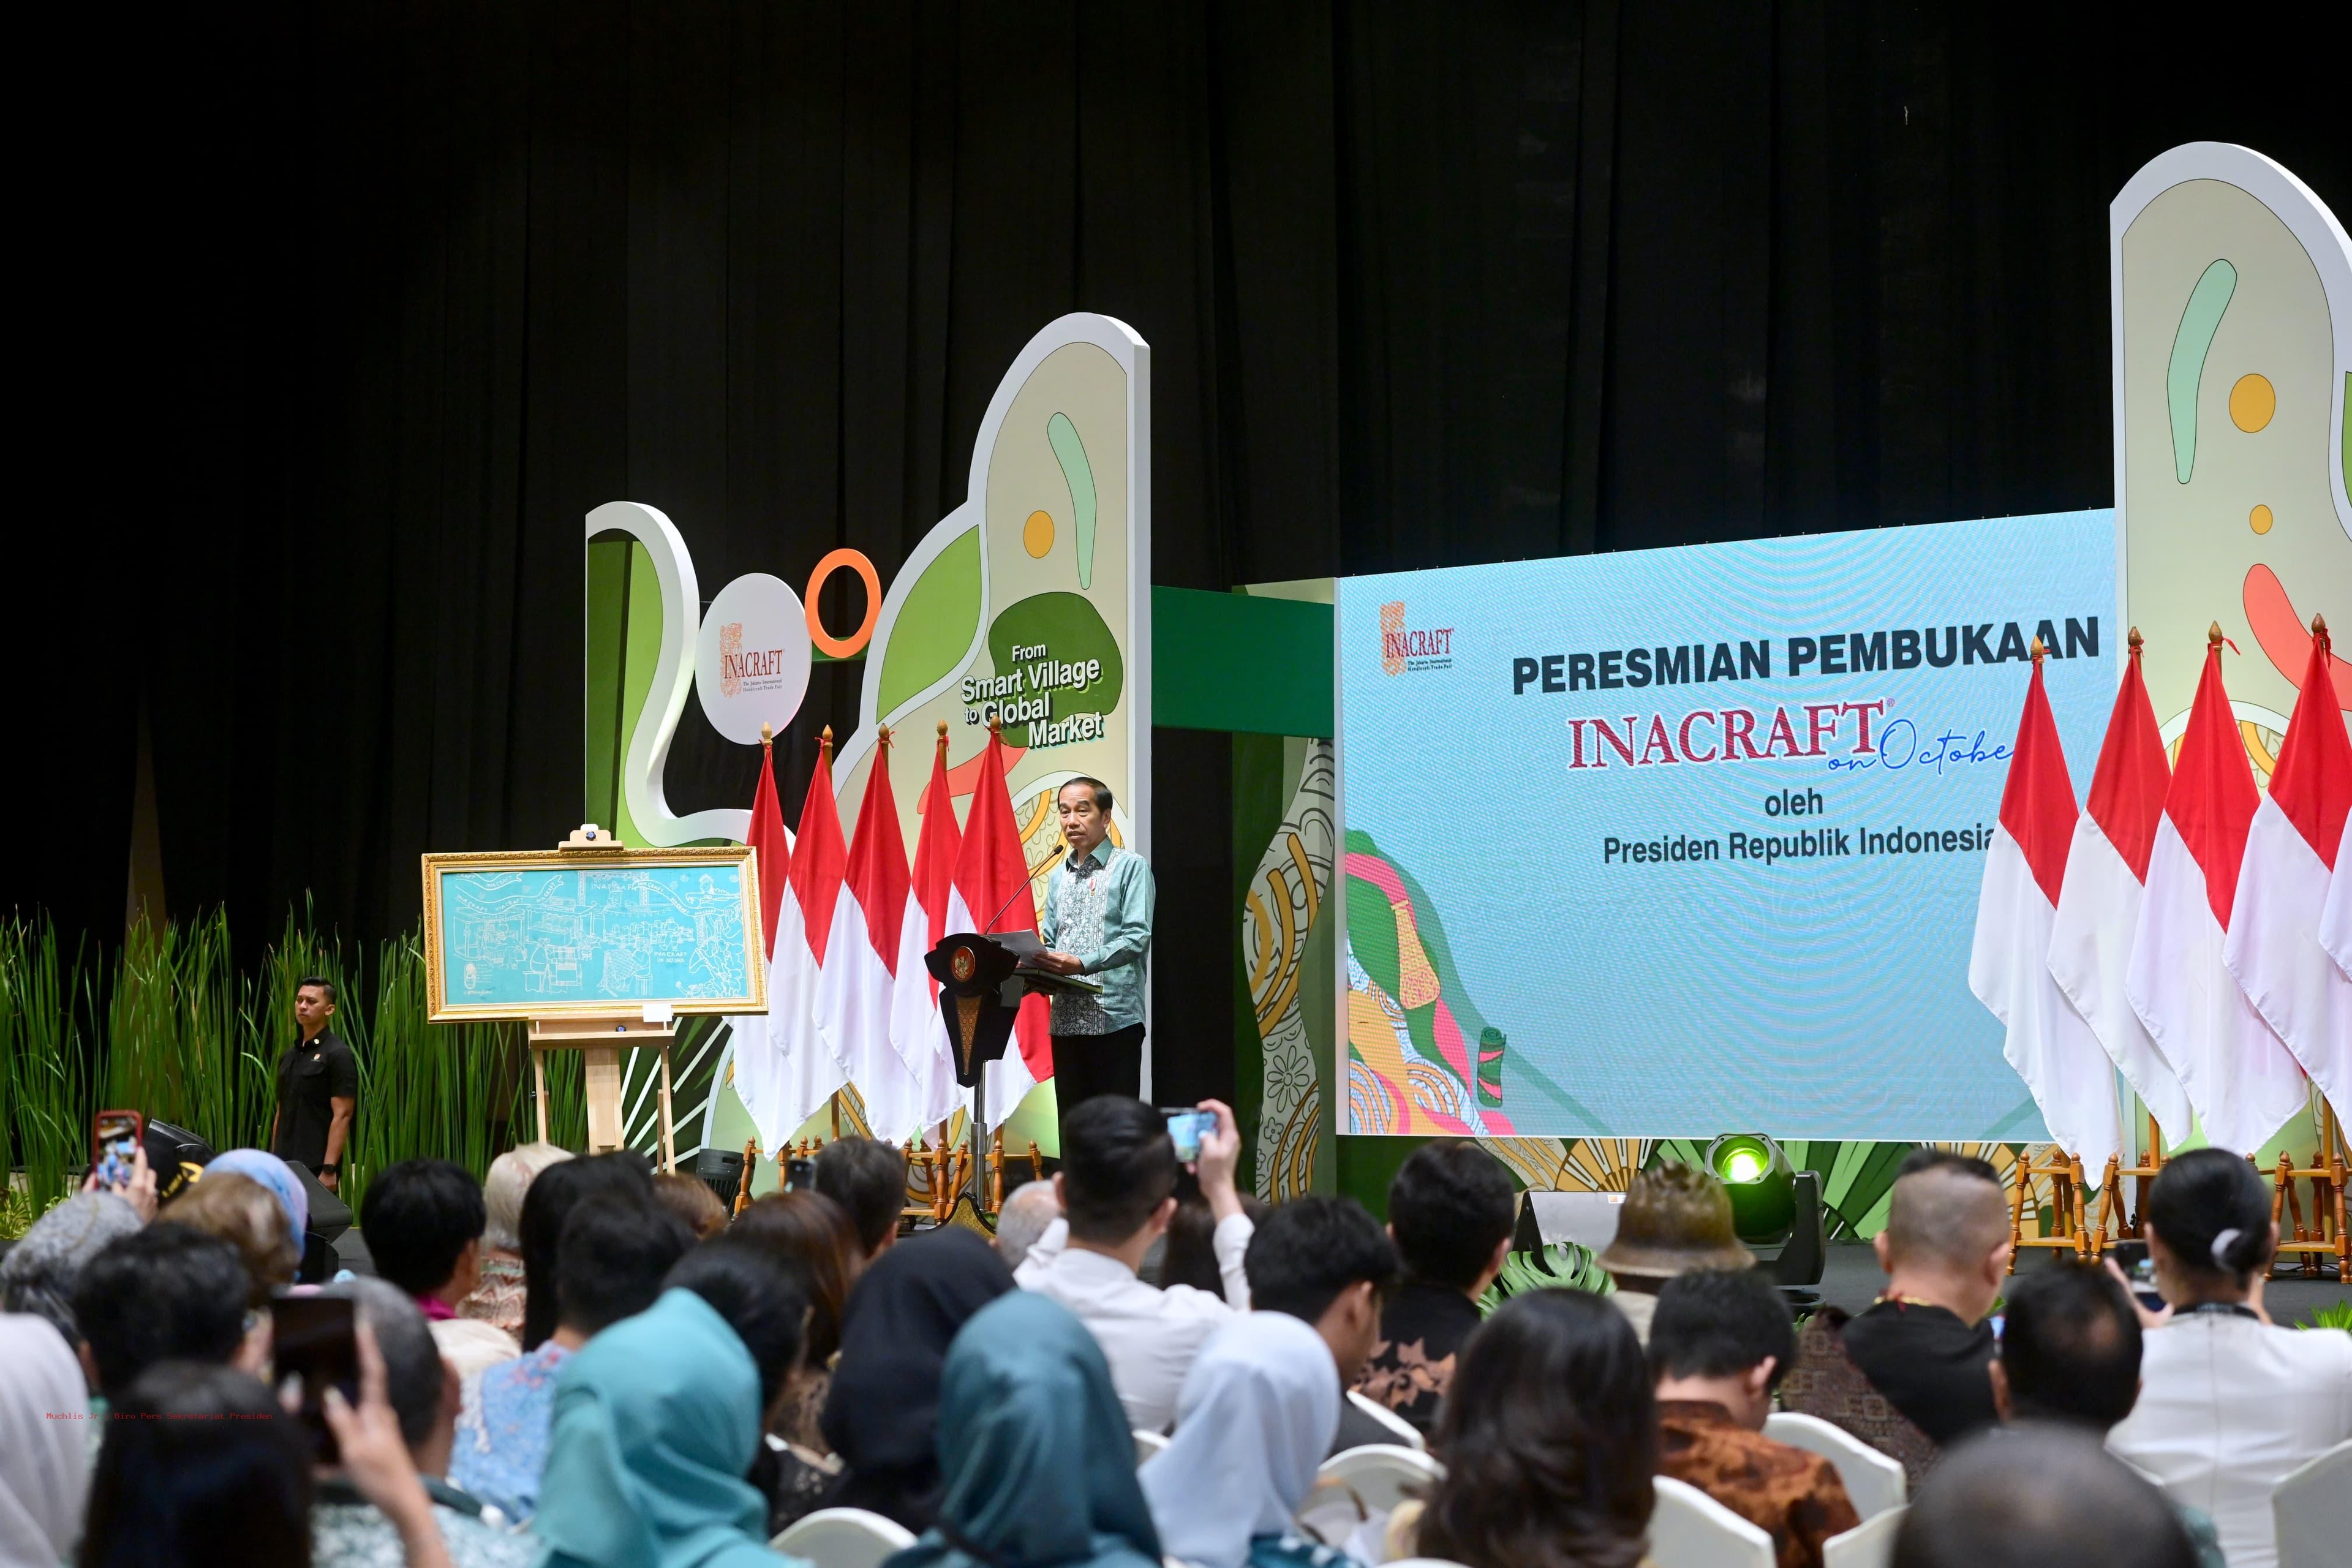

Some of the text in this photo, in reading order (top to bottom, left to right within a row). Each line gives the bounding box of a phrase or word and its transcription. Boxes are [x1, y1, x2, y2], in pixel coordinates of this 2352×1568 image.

[1012, 644, 1047, 662] From
[1385, 627, 1452, 658] INACRAFT
[1513, 616, 2100, 696] PERESMIAN PEMBUKAAN
[724, 649, 783, 679] INACRAFT
[960, 658, 1100, 703] Smart Village
[965, 692, 1050, 728] to Global
[1028, 711, 1102, 747] Market
[1568, 699, 1884, 768] INACRAFT
[1828, 719, 2015, 775] on Octobe
[1765, 788, 1823, 816] oleh
[1604, 834, 1719, 864] Presiden
[1729, 828, 1850, 866] Republik
